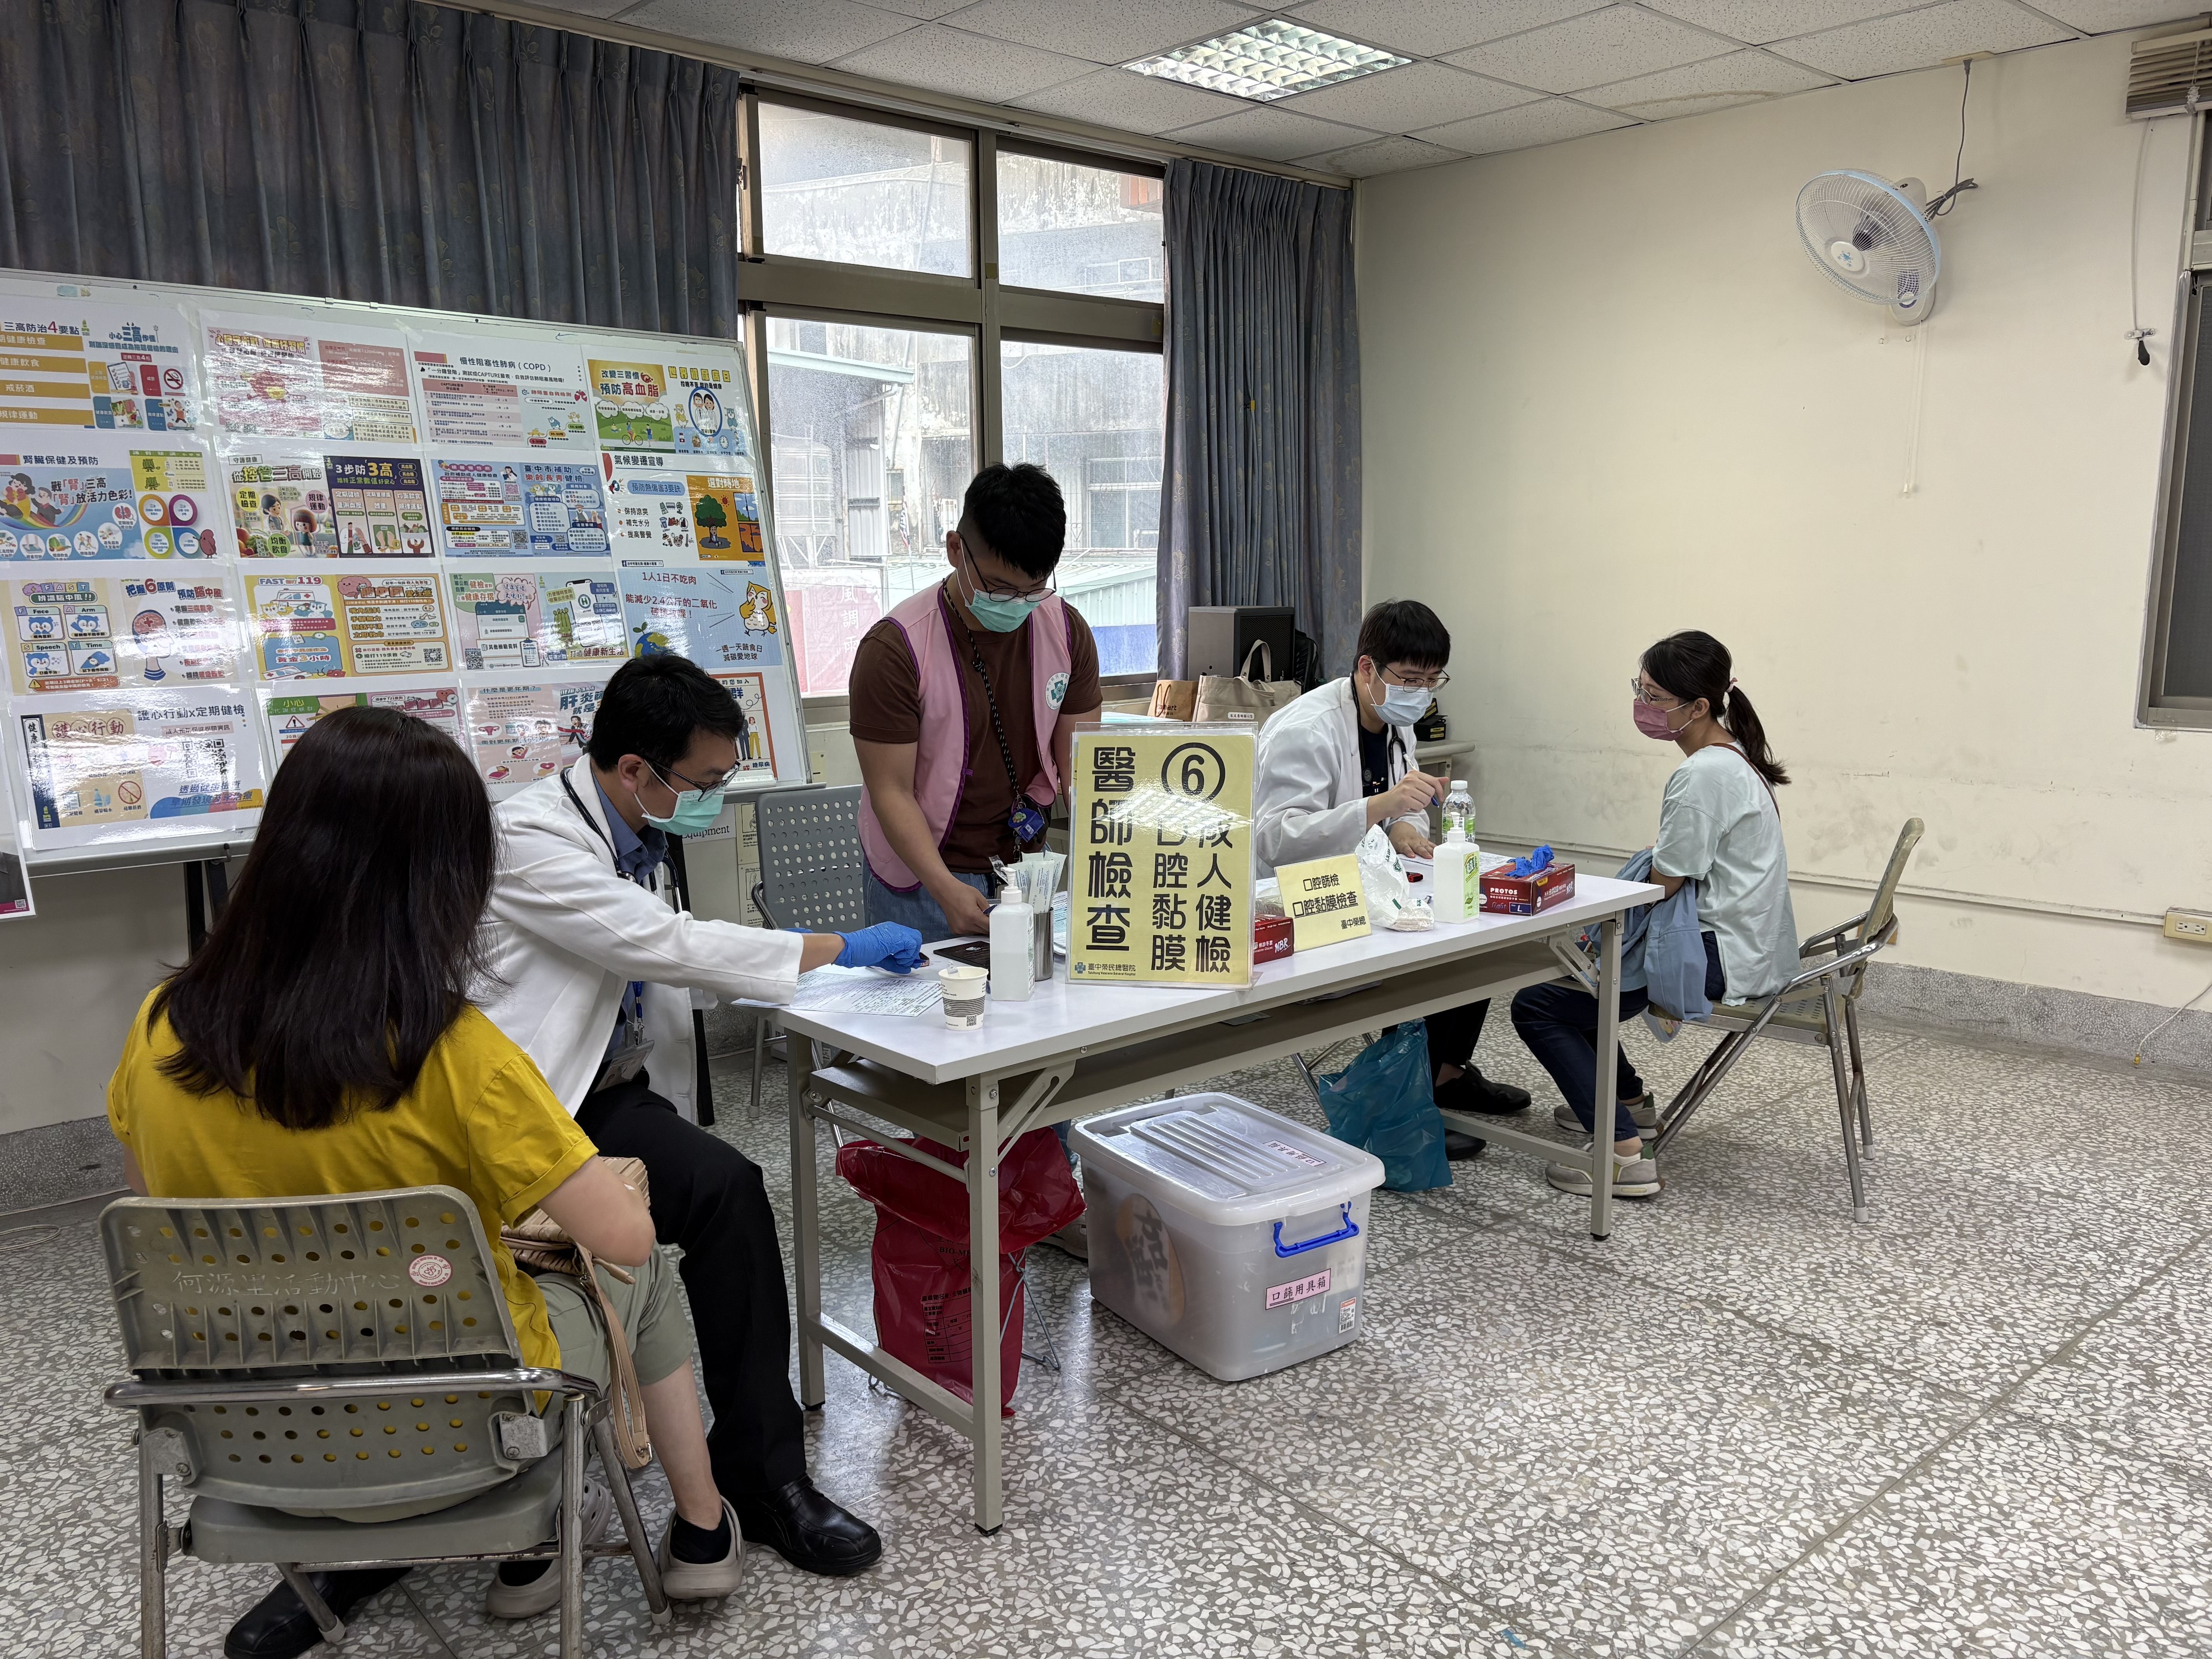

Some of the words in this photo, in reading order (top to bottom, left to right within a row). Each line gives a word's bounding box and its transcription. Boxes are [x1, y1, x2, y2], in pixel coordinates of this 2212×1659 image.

[4, 321, 79, 335] 三高防治4要點
[601, 369, 639, 380] 改變三習慣
[5, 384, 35, 393] 戒菸酒
[600, 382, 659, 397] 預防高血脂
[23, 455, 98, 466] 腎臟保健及預防
[614, 455, 663, 467] 氣候變遷宣導
[524, 465, 572, 473] 臺中市補助
[707, 477, 740, 489] 選對時地
[239, 491, 256, 499] 定期
[241, 500, 258, 508] 檢查
[310, 502, 325, 510] 運動
[624, 507, 649, 516] 保持涼爽
[626, 519, 650, 527] 補充水分
[627, 531, 653, 539] 提高警覺
[271, 537, 287, 545] 均衡
[272, 546, 289, 554] 飲食
[297, 577, 322, 585] 119
[642, 571, 697, 585] 1人1日不吃肉
[625, 593, 718, 609] 能減少2.4公斤的二氧化
[716, 643, 763, 653] 一週一天蔬食日
[723, 652, 758, 662] 減碳愛地球
[283, 699, 305, 708] 小心
[1086, 746, 1136, 951] 醫師檢查
[1303, 873, 1340, 892] 口腔篩檢
[1293, 890, 1358, 919] 口腔黏膜檢查
[1492, 902, 1506, 910] light
[1341, 915, 1366, 930] 臺中榮總
[1088, 963, 1136, 972] 臺中榮民總醫院
[1272, 1276, 1326, 1302] 口篩用具箱
